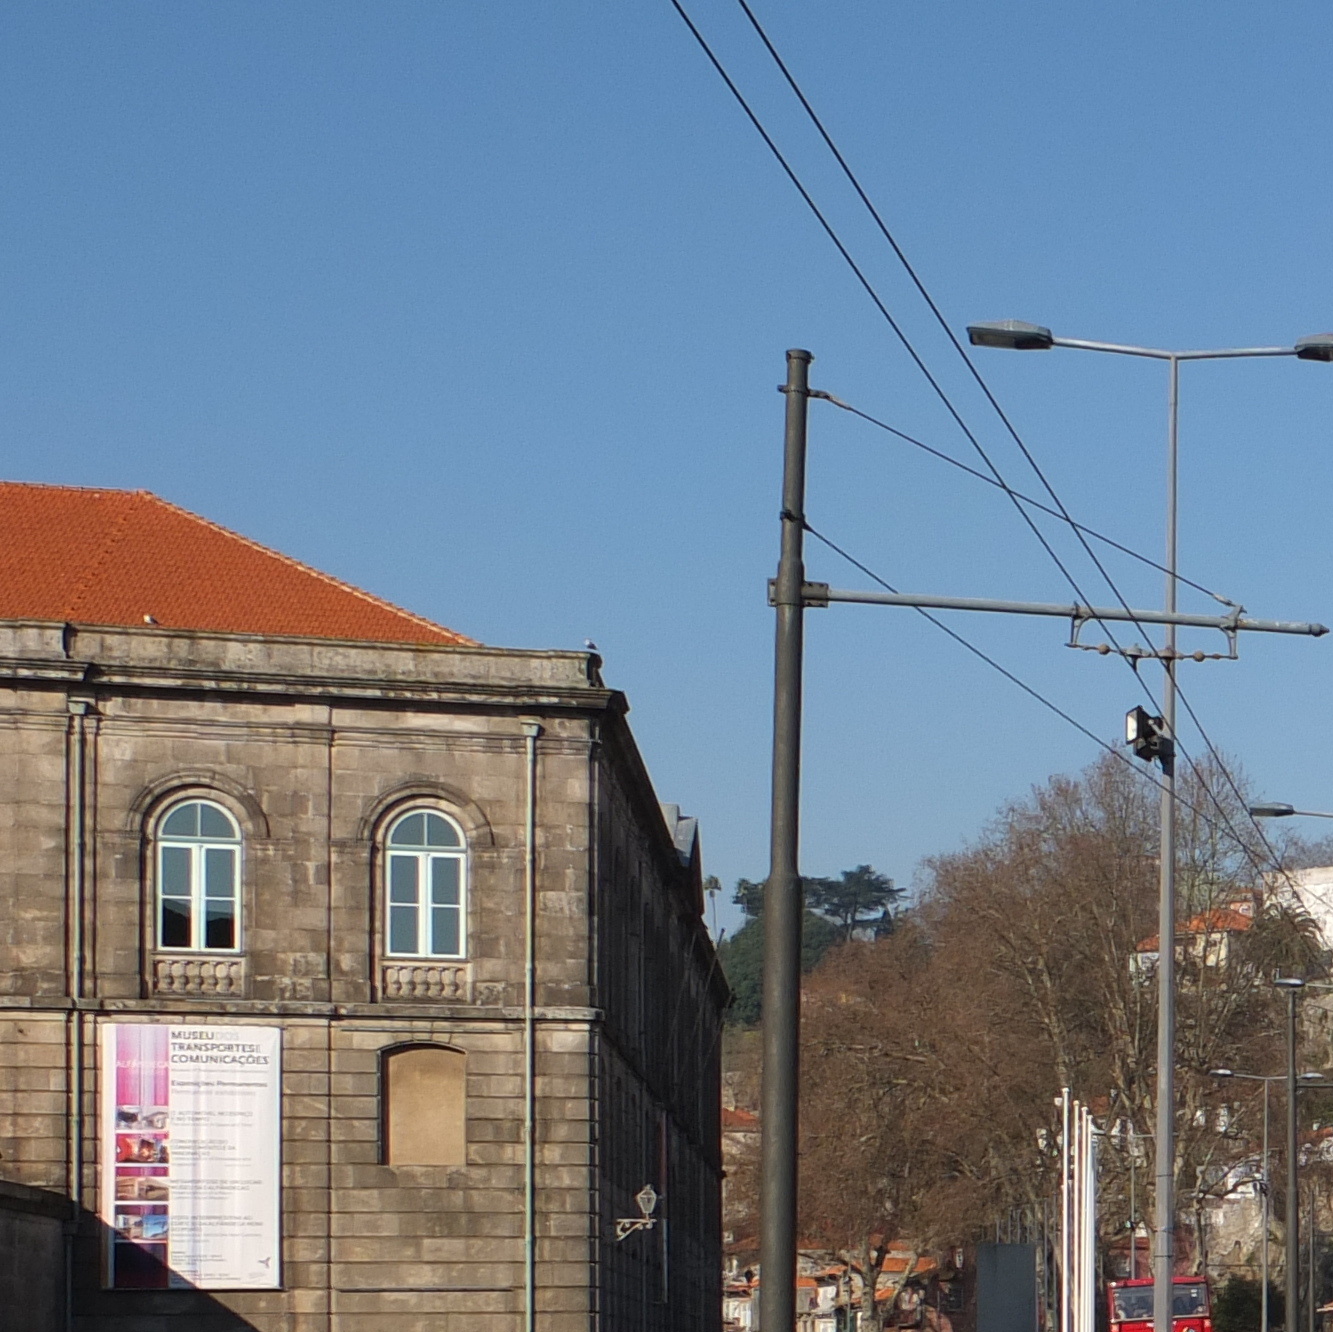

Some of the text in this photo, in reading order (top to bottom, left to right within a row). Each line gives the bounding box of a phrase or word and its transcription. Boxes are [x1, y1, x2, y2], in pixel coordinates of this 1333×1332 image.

[171, 1031, 214, 1040] MUSEU
[171, 1043, 254, 1053] TRANSPORTES
[171, 1054, 269, 1066] COMUNICAÇÕES
